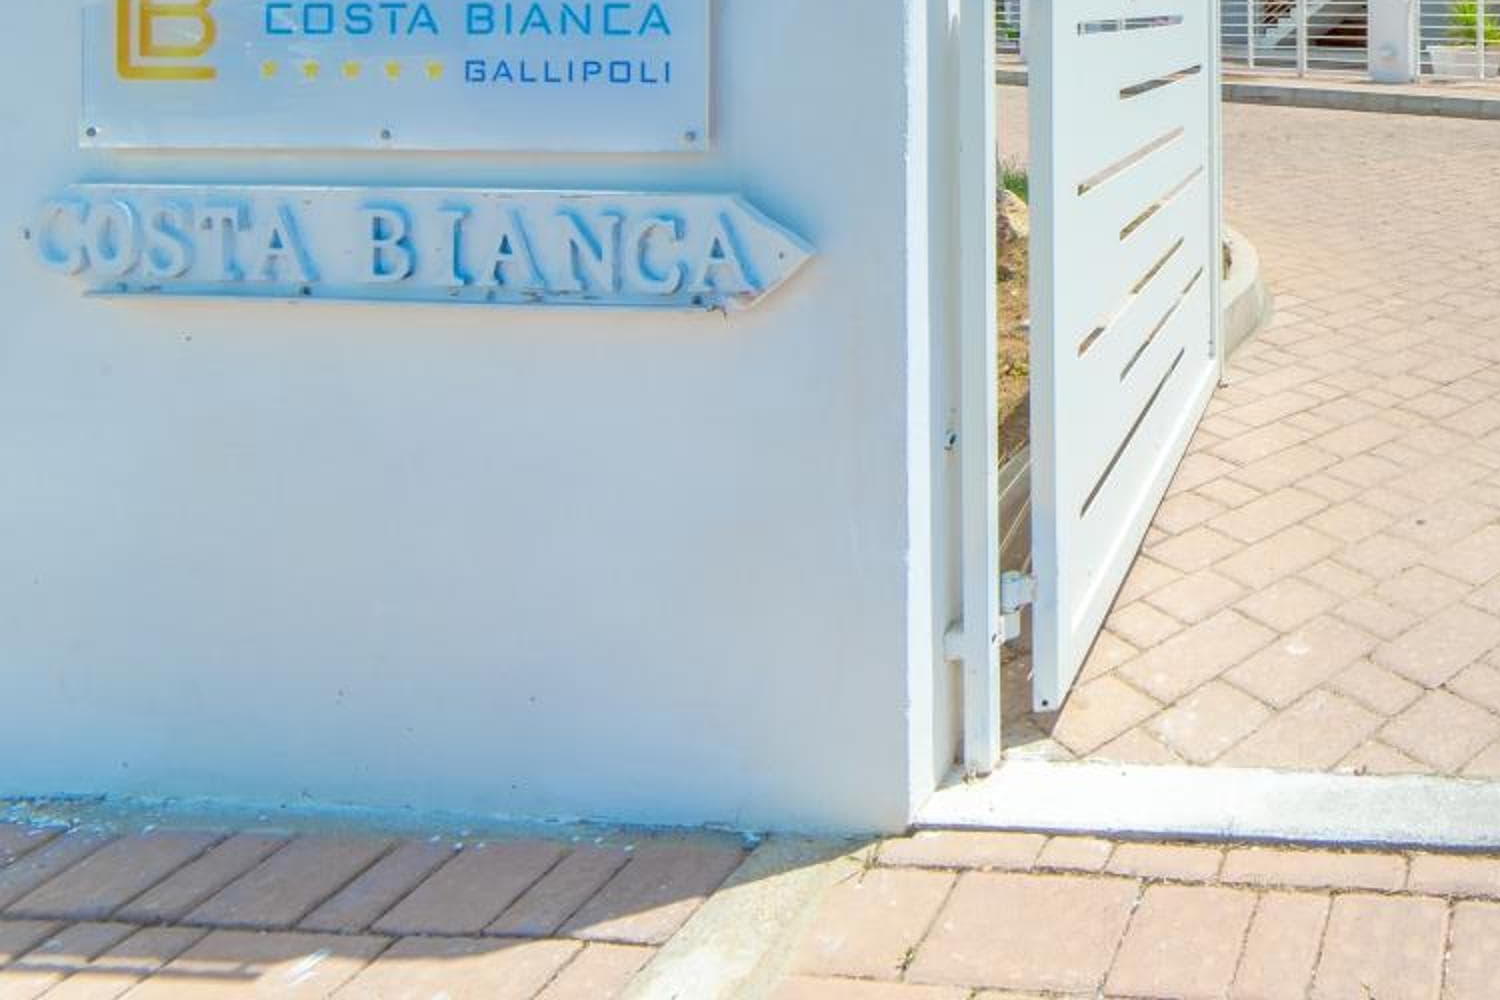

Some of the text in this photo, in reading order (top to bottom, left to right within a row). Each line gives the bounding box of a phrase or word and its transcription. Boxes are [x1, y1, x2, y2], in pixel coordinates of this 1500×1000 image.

[264, 2, 671, 36] COSTA BIANCA
[464, 59, 671, 83] GALLIPOLI
[36, 199, 762, 297] COSTA BIANCA
